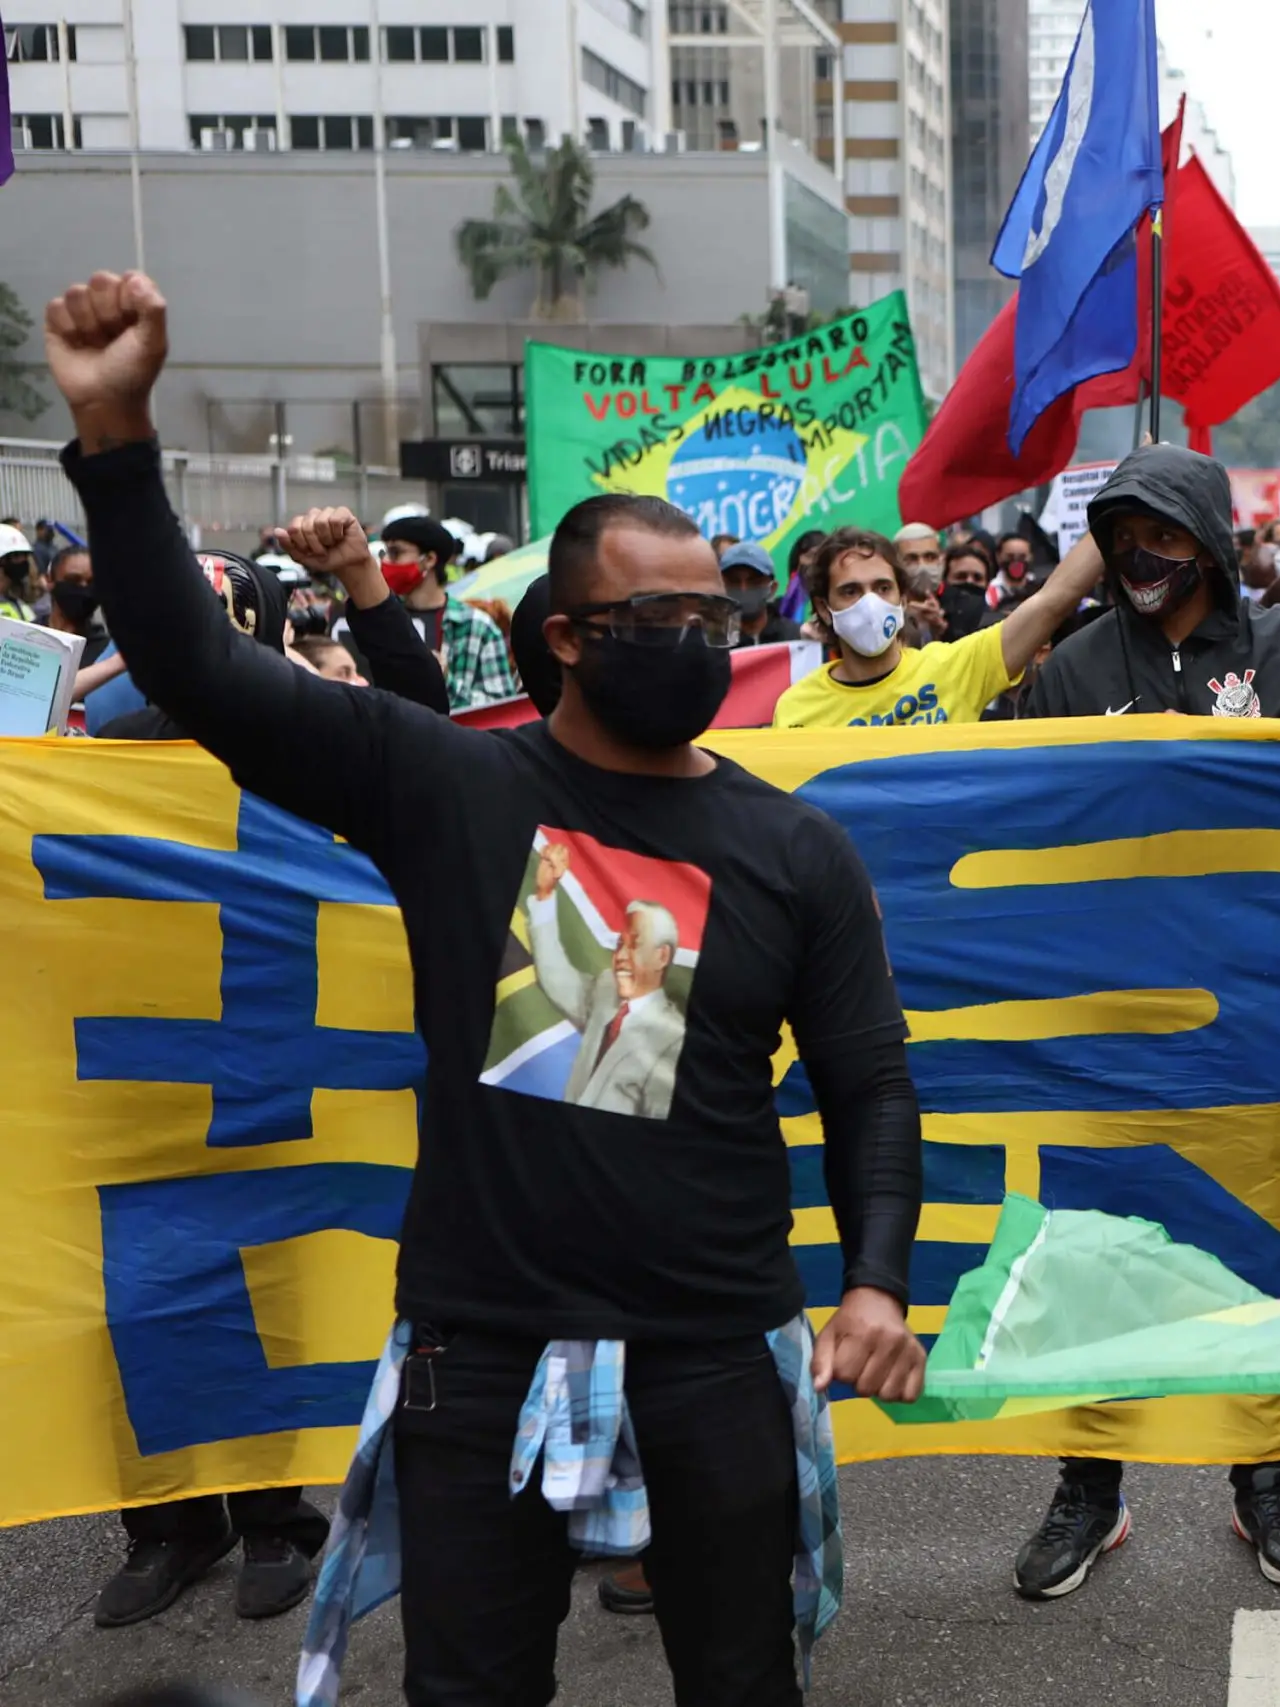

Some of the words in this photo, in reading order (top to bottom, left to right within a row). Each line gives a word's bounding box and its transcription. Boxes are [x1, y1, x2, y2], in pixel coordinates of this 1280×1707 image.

[574, 360, 646, 387] FORA
[681, 317, 868, 382] BOLSONARO
[583, 380, 717, 422] VOLTA
[759, 345, 870, 400] LULA
[583, 412, 685, 479] VIDAS
[704, 397, 817, 442] NEGRAS
